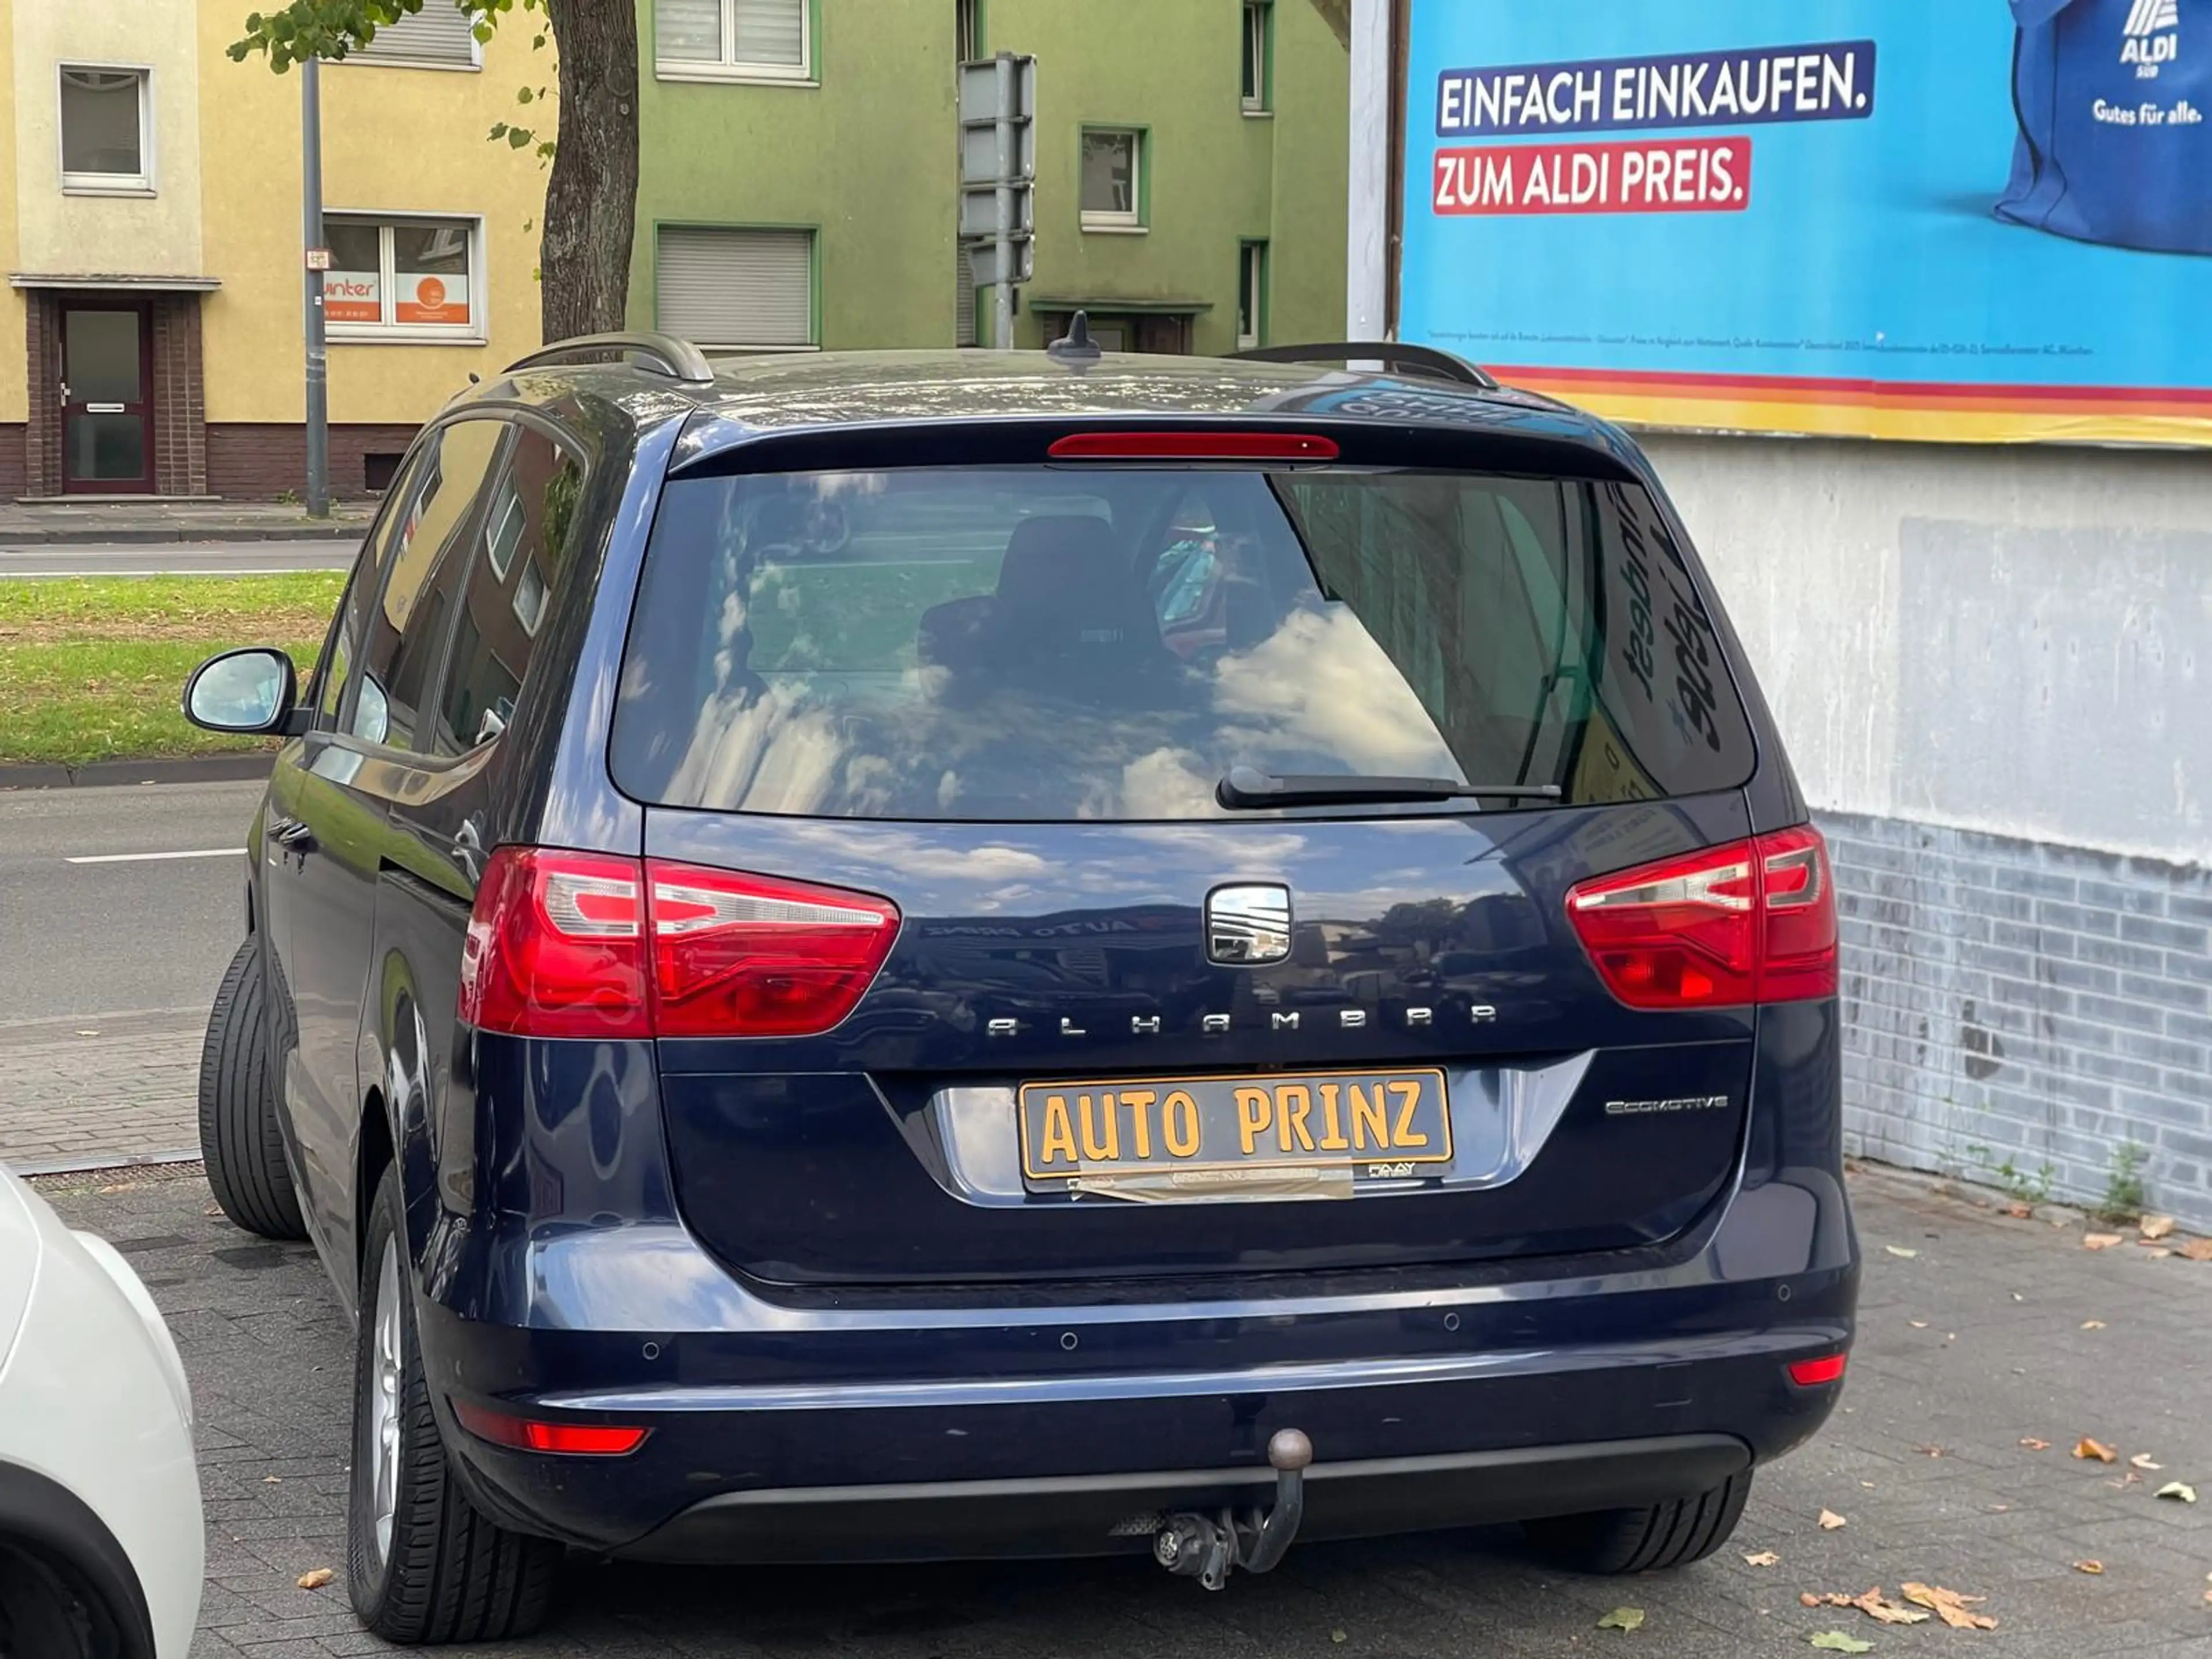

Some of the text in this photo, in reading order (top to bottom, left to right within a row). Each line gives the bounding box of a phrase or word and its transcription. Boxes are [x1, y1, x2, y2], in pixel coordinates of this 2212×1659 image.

[2119, 33, 2177, 64] ALDI
[1441, 52, 1866, 128] EINFACH EINKAUFEN.
[2092, 99, 2202, 126] Gutes für alle.
[1436, 147, 1743, 206] ZUM ALDI PREIS.
[987, 1004, 1498, 1036] ALHAMBRA
[1041, 1080, 1428, 1163] AUTO PRINZ
